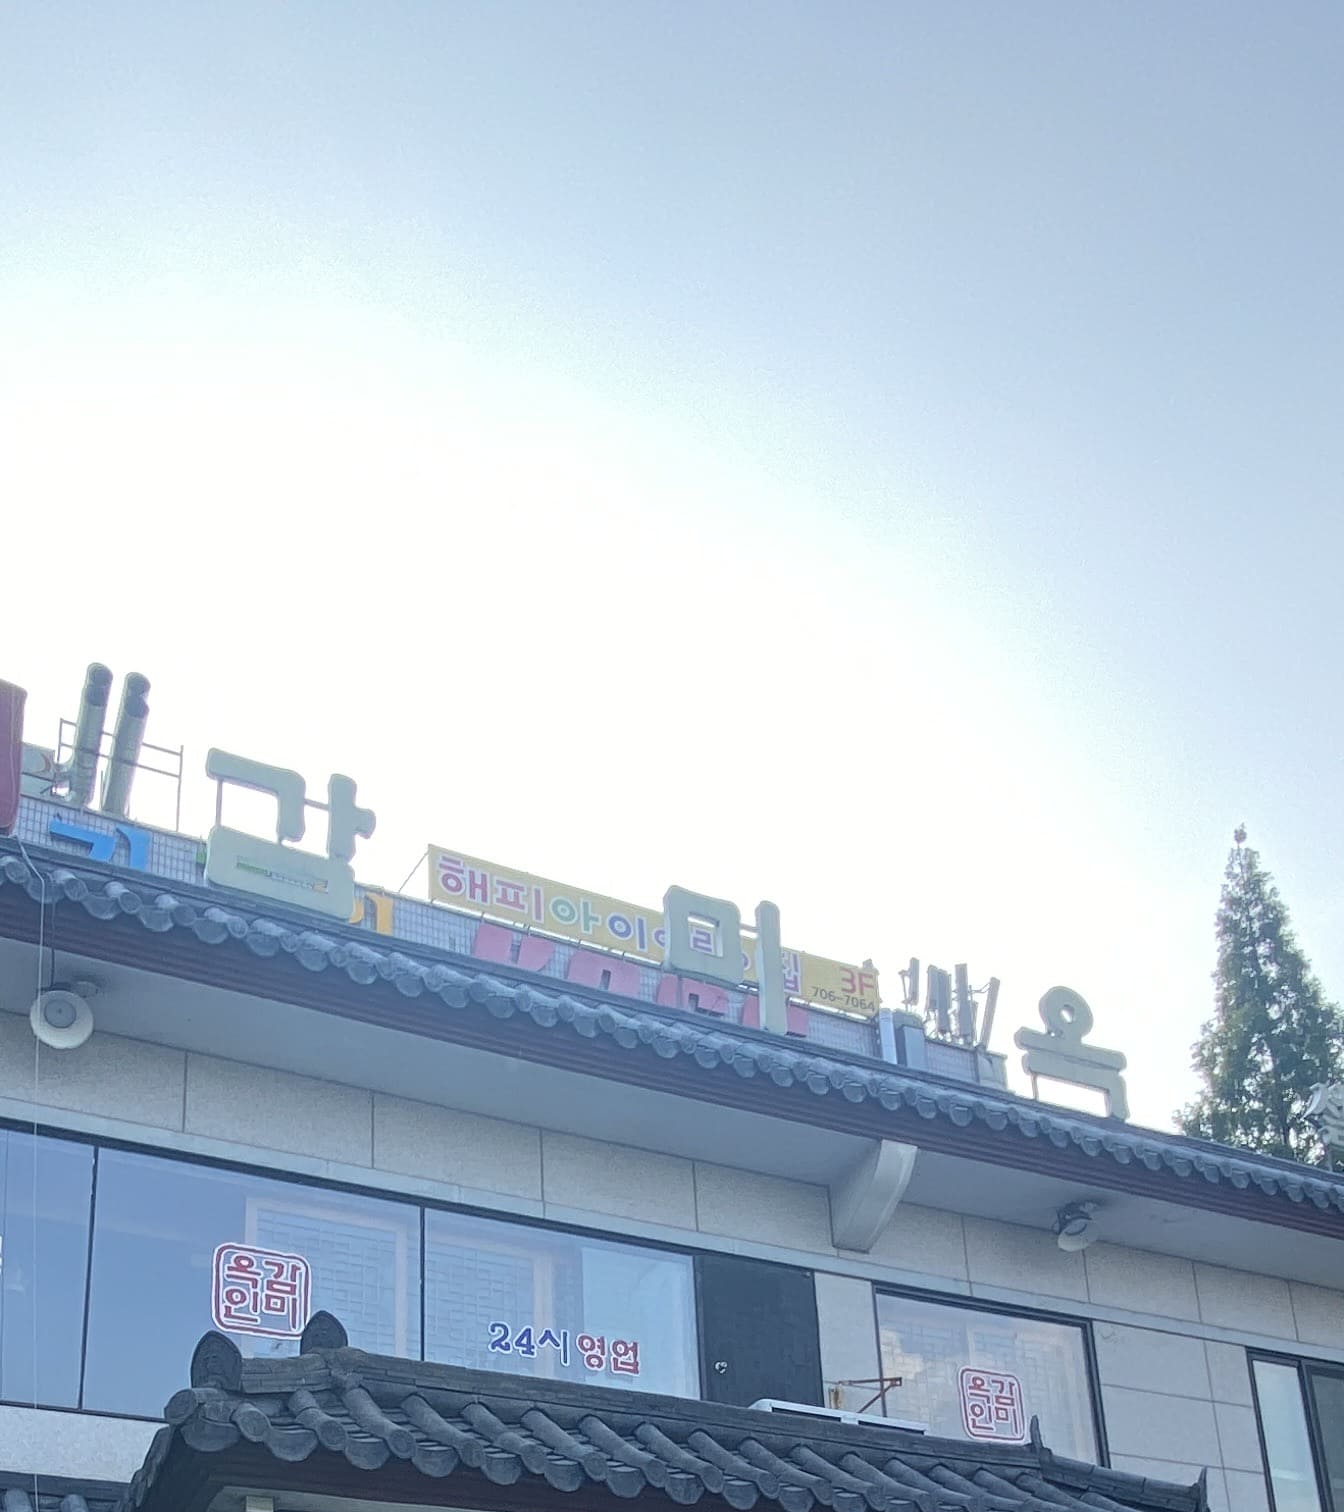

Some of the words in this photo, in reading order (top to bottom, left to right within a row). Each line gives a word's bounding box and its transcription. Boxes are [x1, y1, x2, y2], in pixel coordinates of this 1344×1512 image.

[839, 970, 876, 998] 3F
[488, 1321, 570, 1367] 24시
[576, 1333, 640, 1377] 영업
